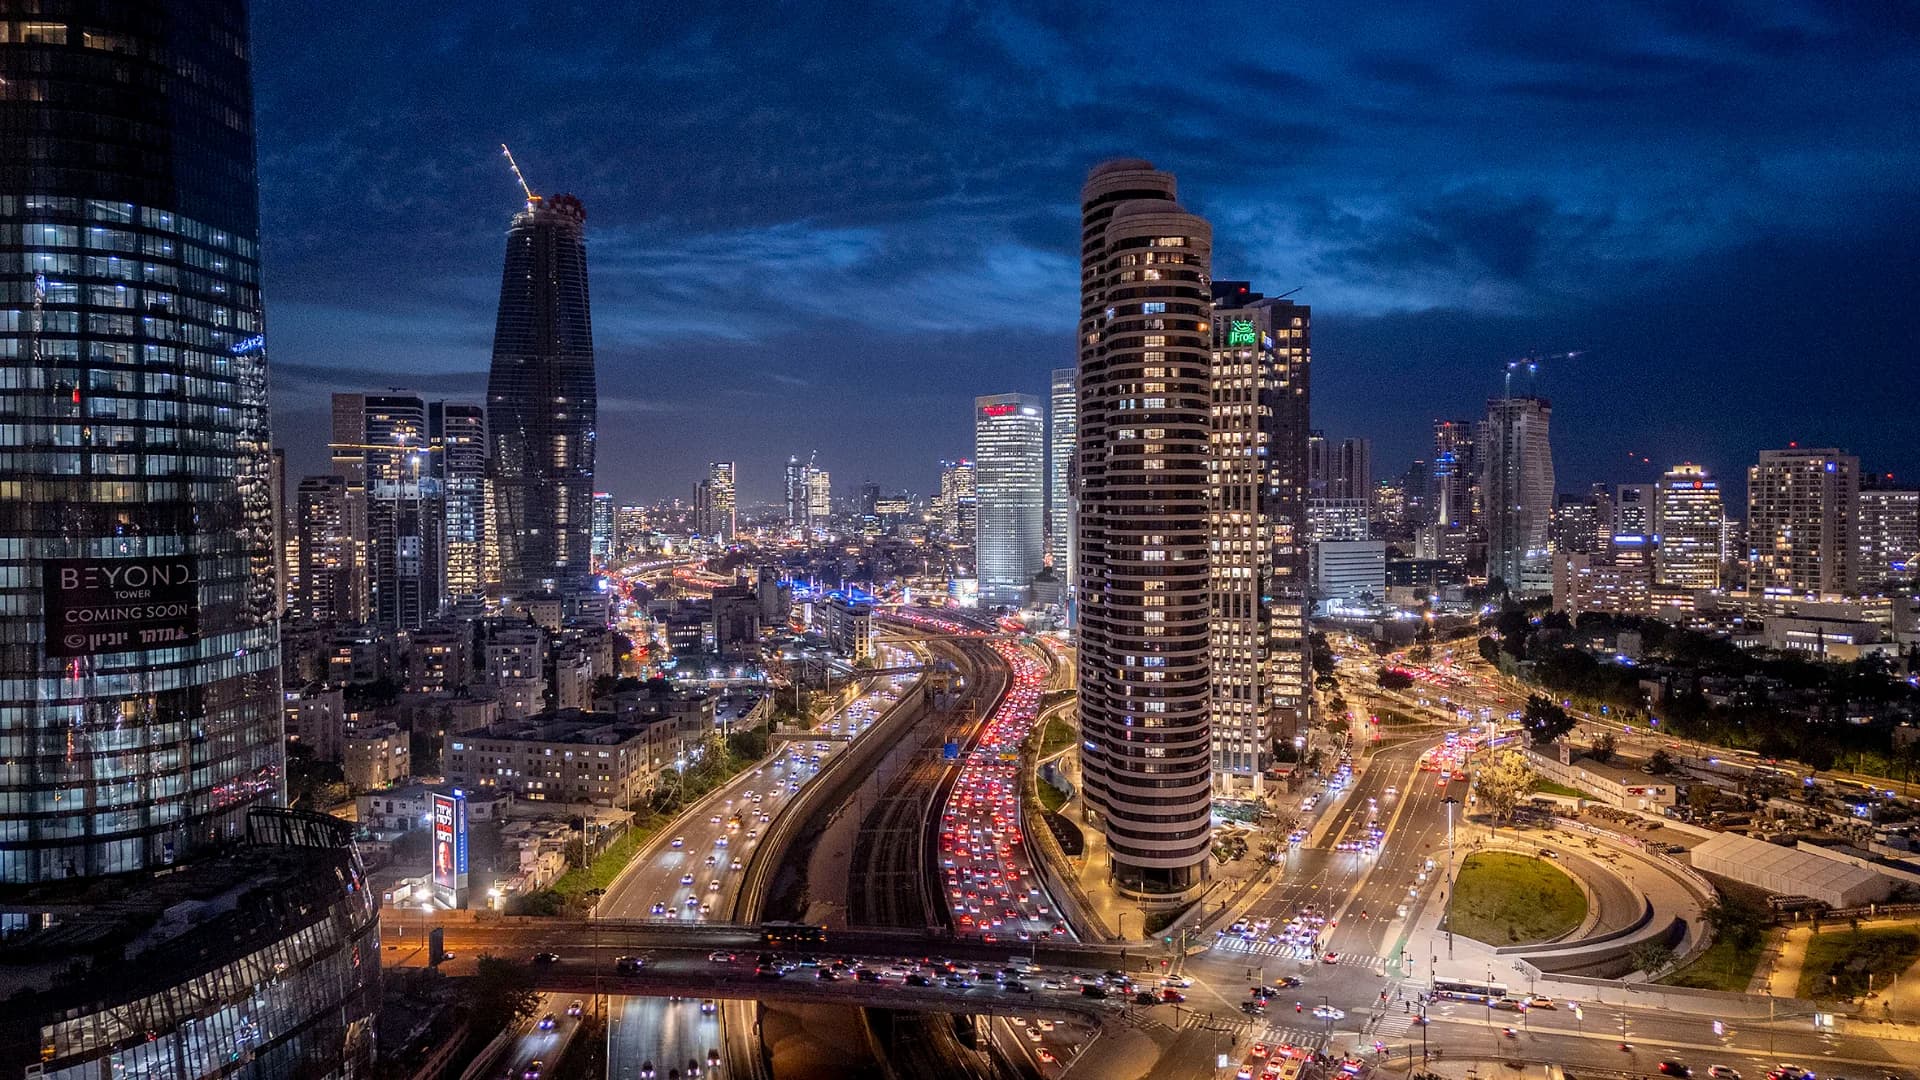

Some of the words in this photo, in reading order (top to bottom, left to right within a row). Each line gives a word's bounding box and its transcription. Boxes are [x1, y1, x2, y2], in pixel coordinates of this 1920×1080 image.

[1231, 332, 1256, 344] JFrog
[61, 564, 189, 590] BEYOND
[114, 589, 151, 599] TOWER
[65, 607, 142, 623] COMING
[146, 604, 188, 618] SOON
[139, 628, 175, 644] תדהר
